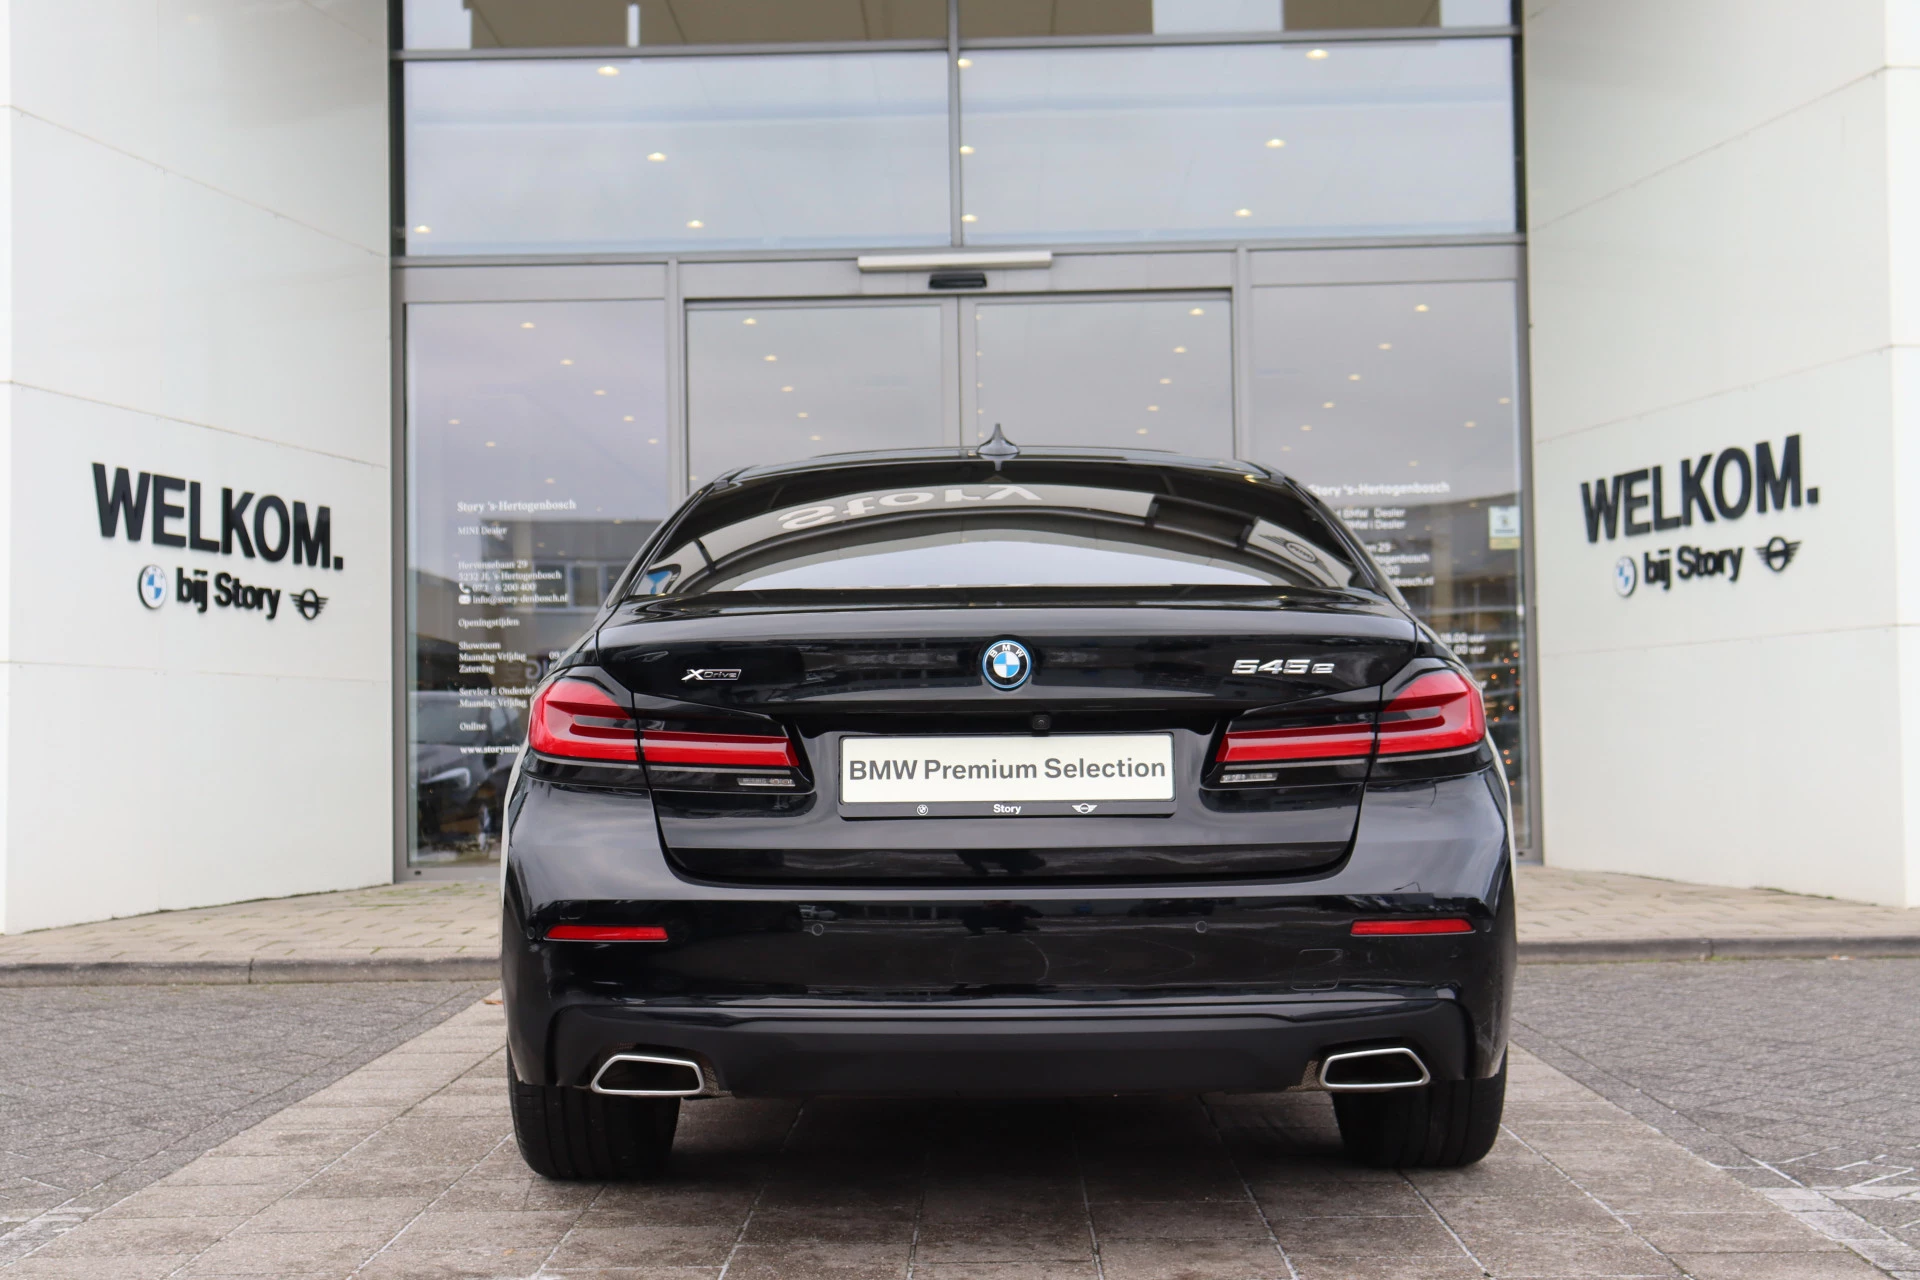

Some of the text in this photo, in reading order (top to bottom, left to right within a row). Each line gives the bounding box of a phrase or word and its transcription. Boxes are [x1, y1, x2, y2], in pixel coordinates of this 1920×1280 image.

[1580, 434, 1819, 544] WELKOM.
[456, 500, 485, 514] Story
[1374, 507, 1406, 518] Dealer
[91, 462, 345, 570] WELKOM.
[457, 525, 508, 536] MINI Dealer
[1375, 519, 1407, 530] Dealer
[517, 560, 528, 569] 29
[1643, 545, 1744, 590] bij Story
[176, 567, 281, 621] bij Story
[458, 617, 520, 629] Openingstijden
[458, 640, 502, 650] Showroom
[458, 663, 496, 675] Zaterdag
[459, 687, 490, 697] Service
[491, 687, 497, 697] &
[459, 721, 487, 732] Online
[848, 757, 1167, 781] BMW Premium Selection
[993, 803, 1022, 816] Story
